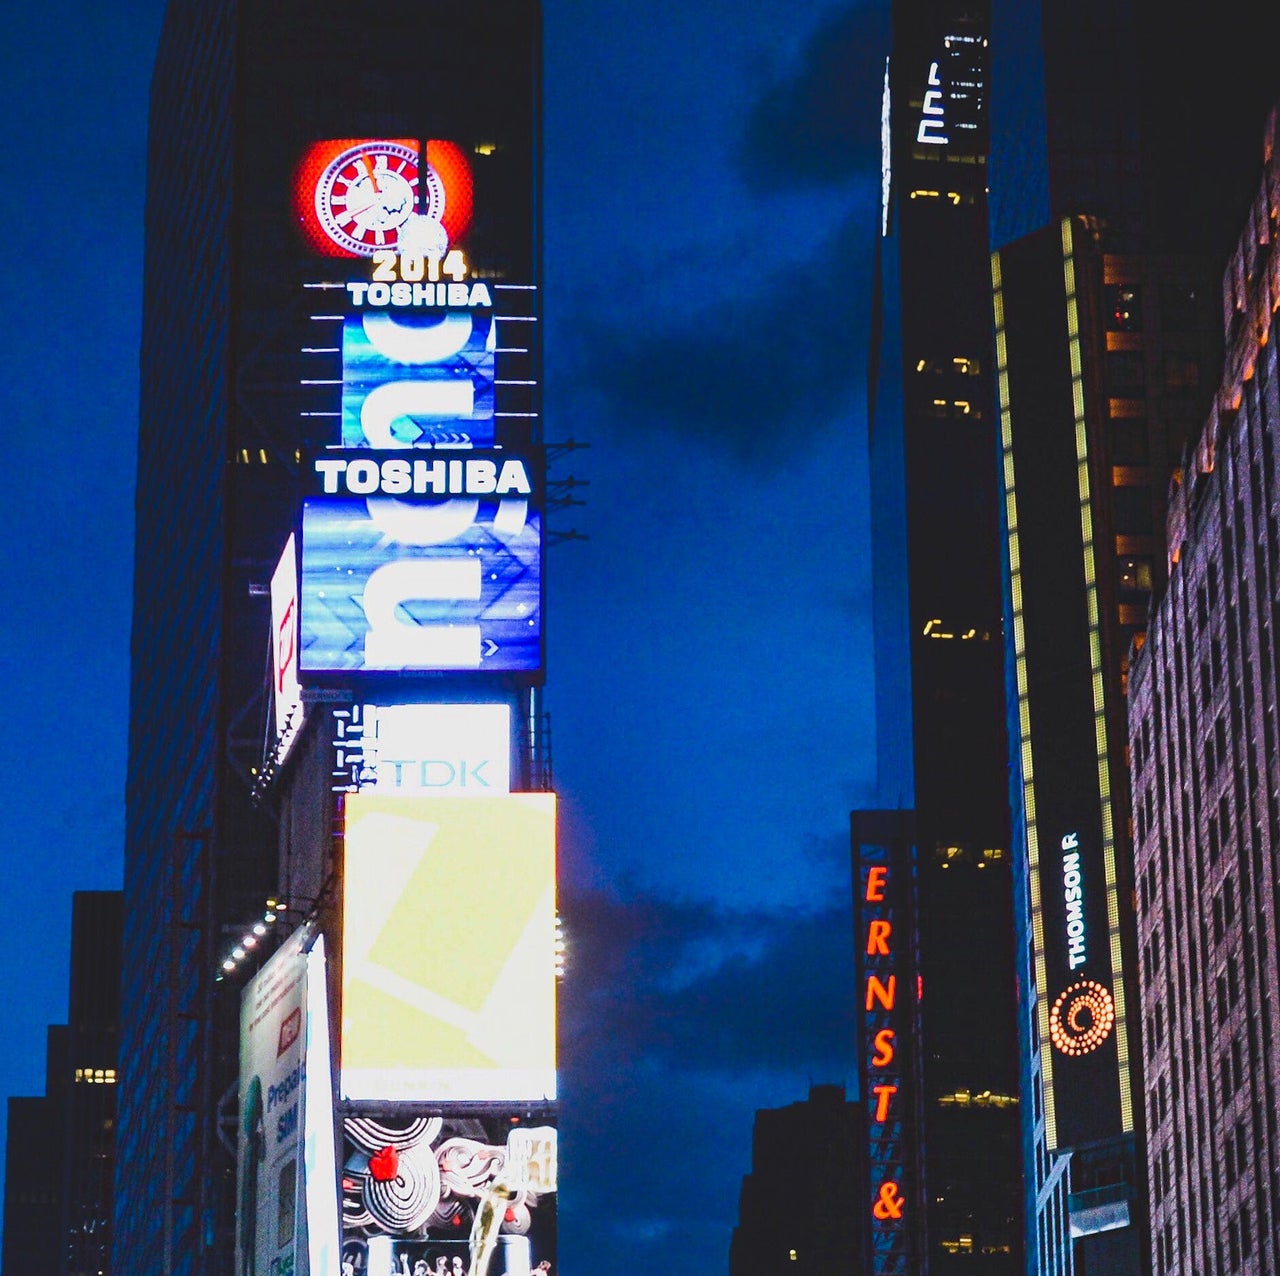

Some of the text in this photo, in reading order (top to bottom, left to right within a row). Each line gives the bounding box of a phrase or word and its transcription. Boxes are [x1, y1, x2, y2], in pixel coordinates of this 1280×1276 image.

[371, 249, 469, 283] 2014
[346, 282, 492, 307] TOSHIBA
[314, 459, 531, 494] TOSHIBA
[381, 760, 490, 787] TDK
[1062, 851, 1085, 970] THOMSON
[865, 866, 897, 1122] ERNST
[873, 1181, 905, 1220] &
